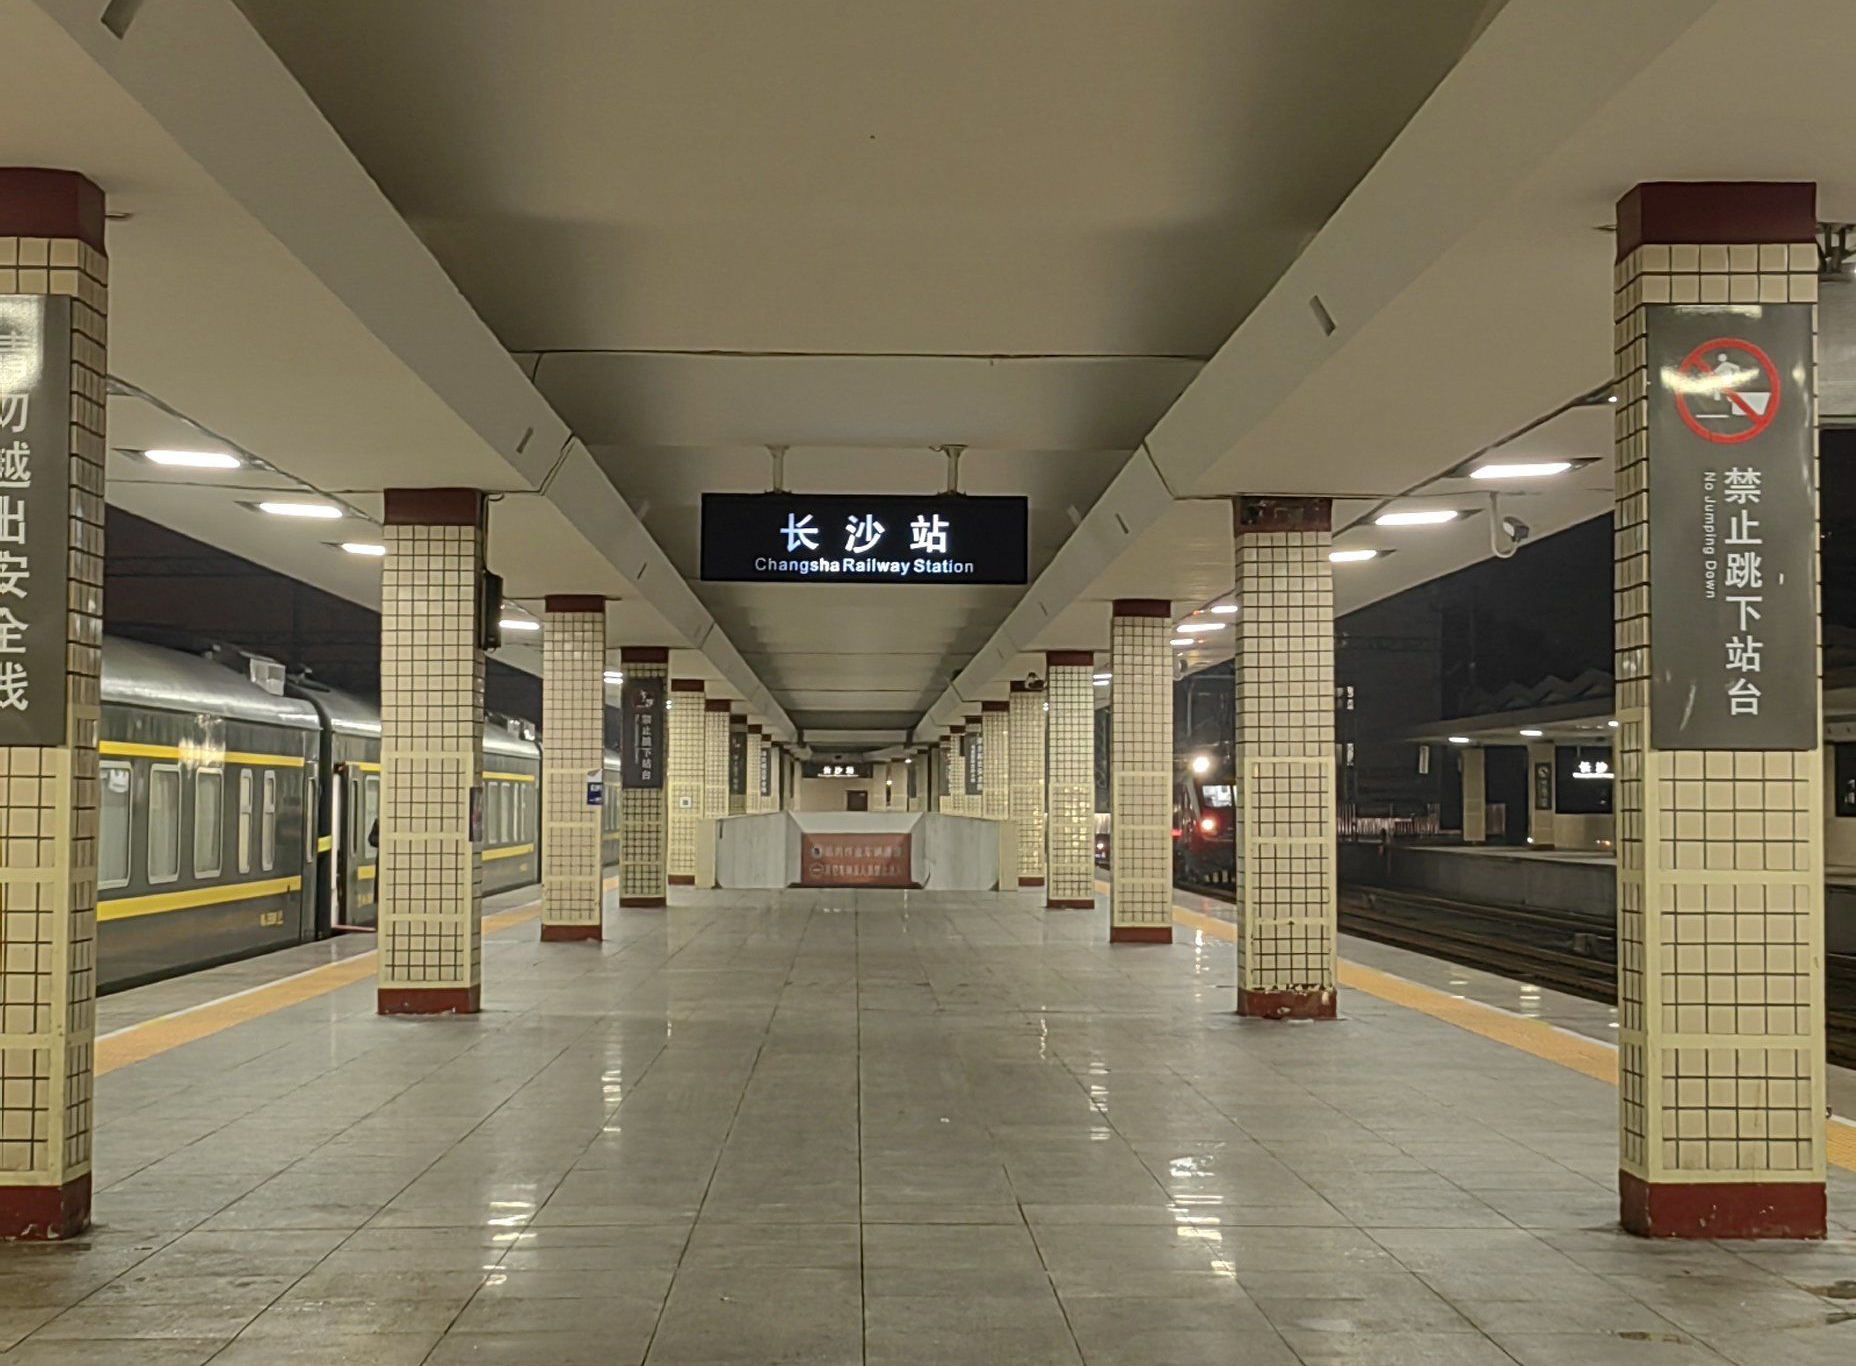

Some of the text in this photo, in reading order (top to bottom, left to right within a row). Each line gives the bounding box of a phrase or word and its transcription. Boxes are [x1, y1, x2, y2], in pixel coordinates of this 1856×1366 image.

[755, 557, 974, 575] Changsha Railway Station
[780, 513, 949, 553] 长沙站
[1703, 472, 1717, 599] No Jumping Down
[1724, 467, 1763, 715] 禁止跳下站台
